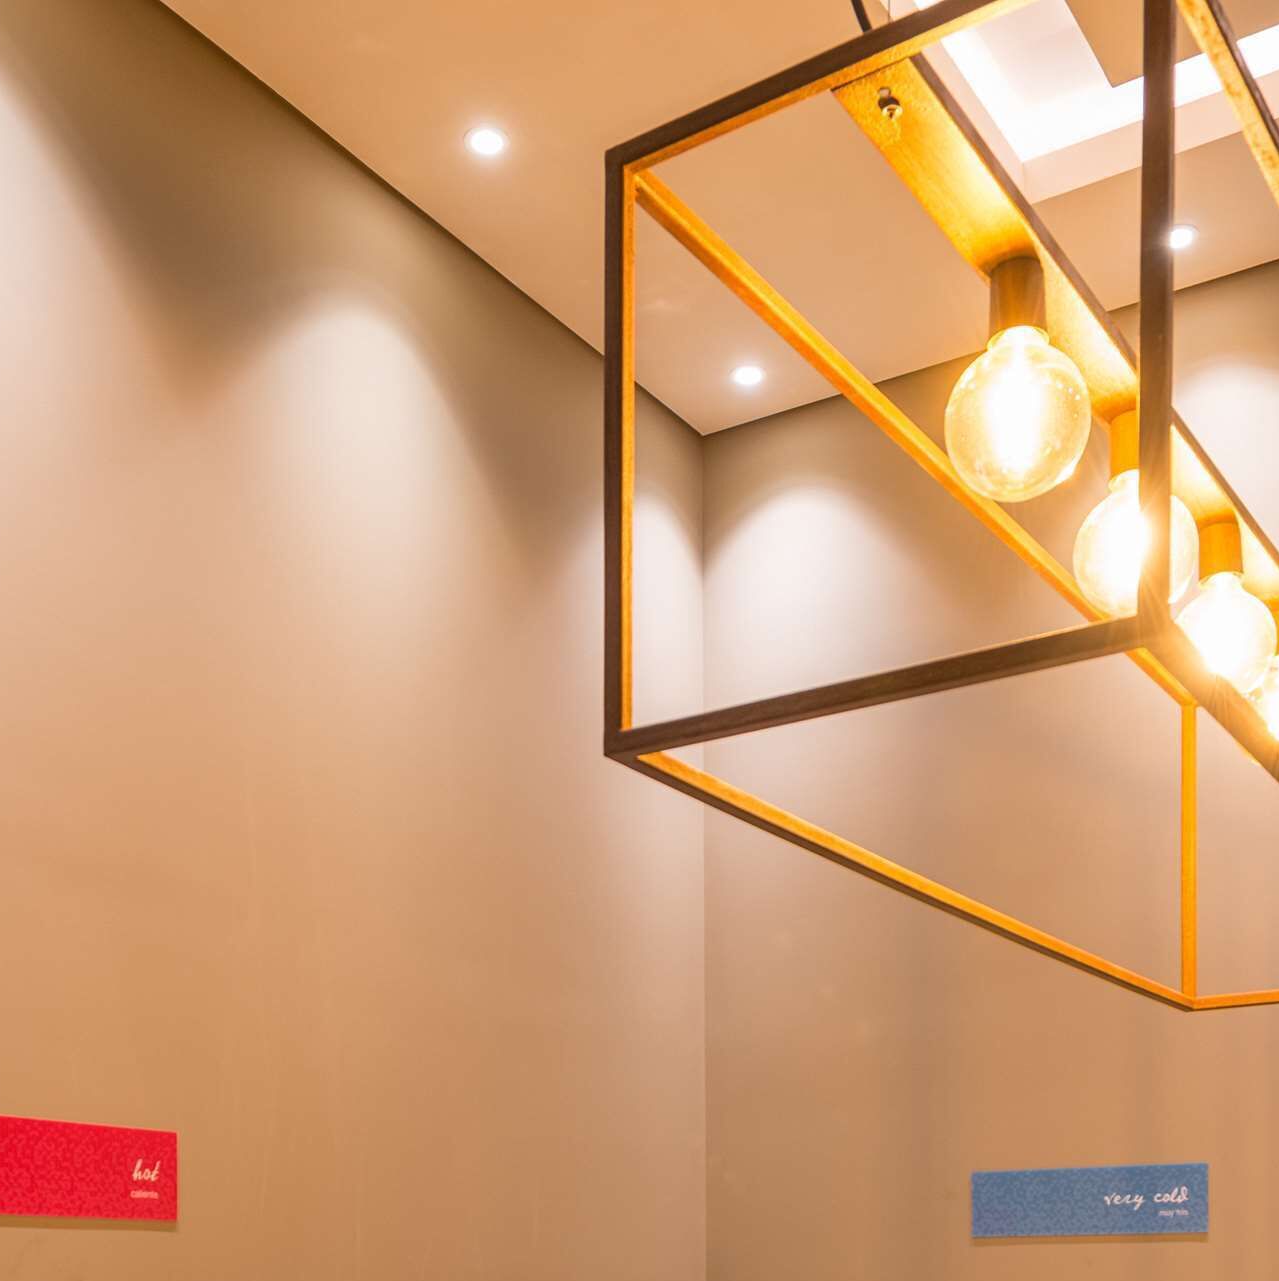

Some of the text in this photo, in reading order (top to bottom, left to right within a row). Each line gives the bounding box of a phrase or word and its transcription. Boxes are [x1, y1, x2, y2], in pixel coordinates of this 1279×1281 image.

[132, 1158, 161, 1182] hot
[1103, 1186, 1189, 1211] very cold
